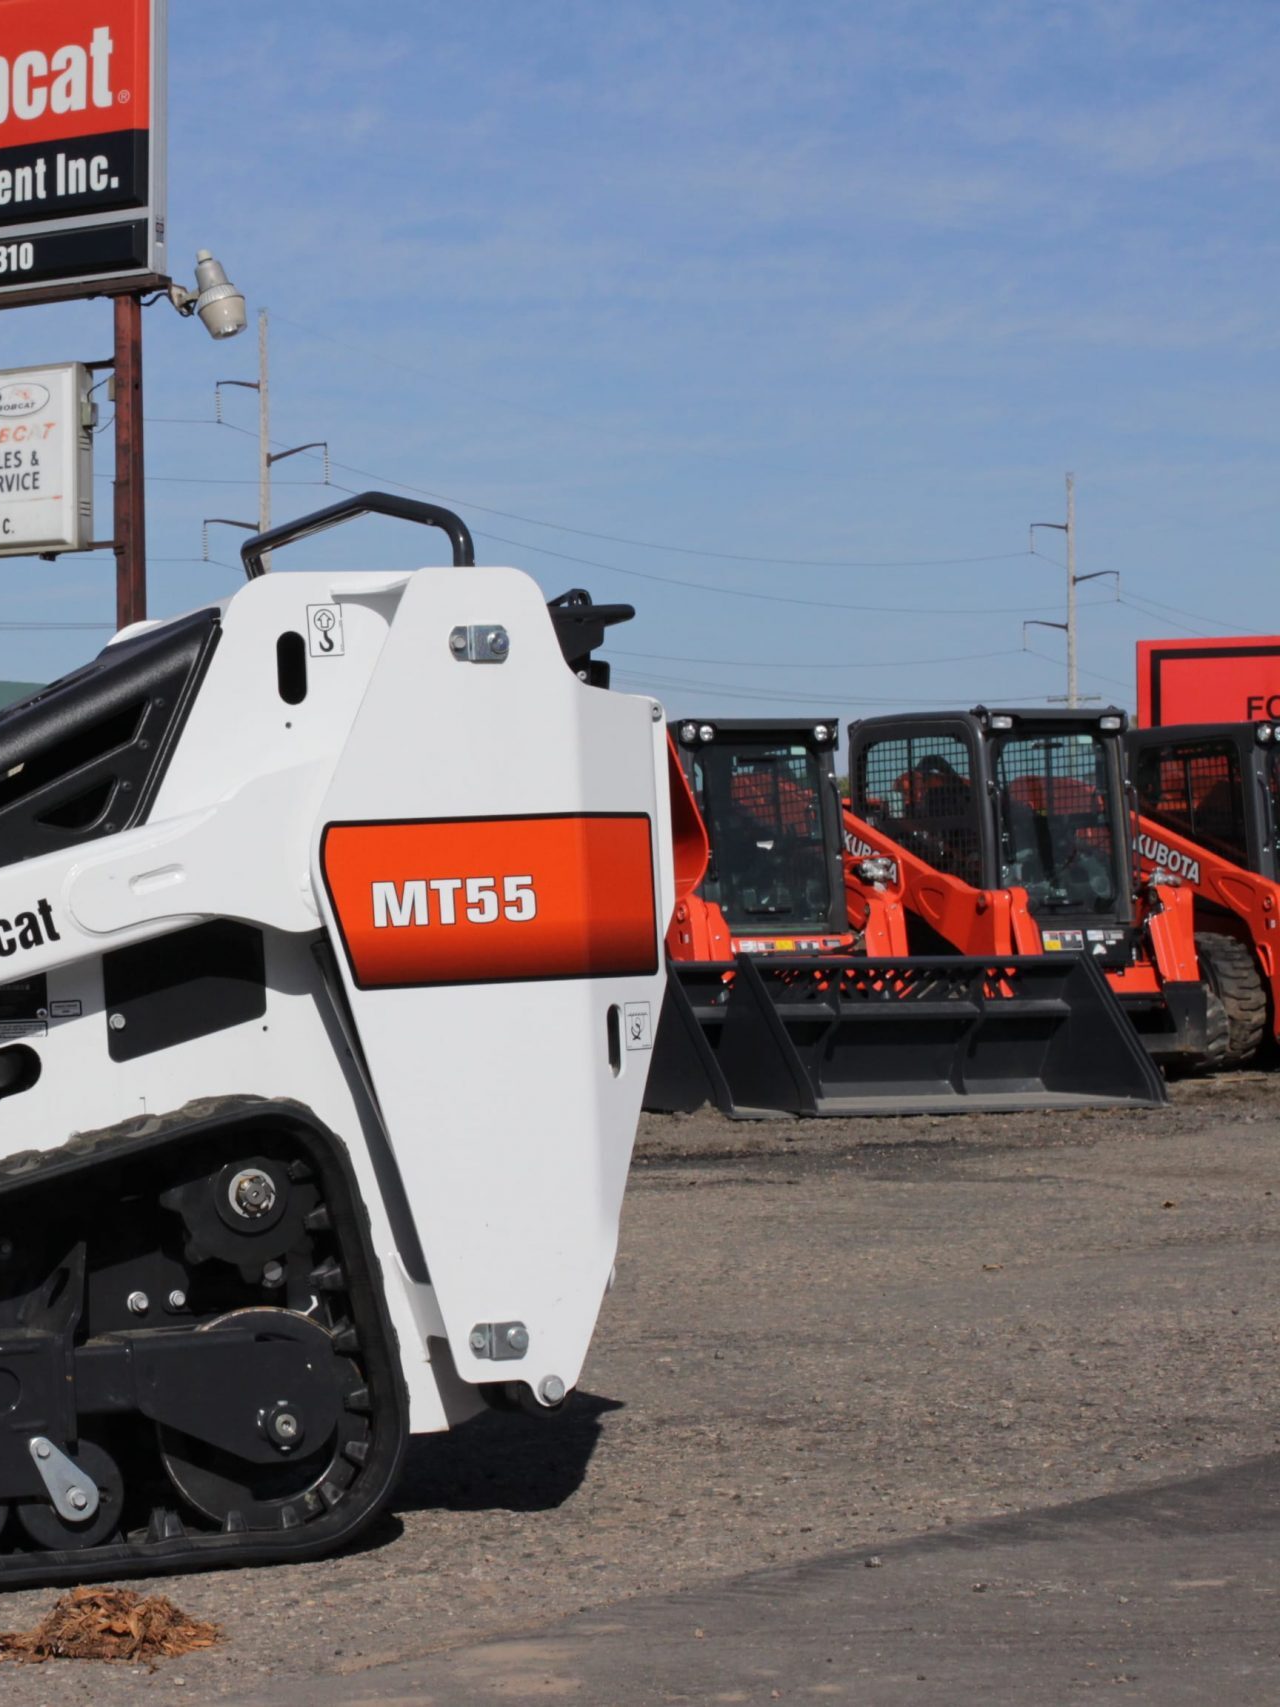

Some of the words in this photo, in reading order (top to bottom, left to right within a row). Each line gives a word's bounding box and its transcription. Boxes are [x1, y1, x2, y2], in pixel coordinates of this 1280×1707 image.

[56, 153, 119, 196] Inc.
[30, 450, 40, 467] &
[843, 830, 897, 884] KUBA
[1132, 833, 1200, 884] KUBOTA
[371, 875, 538, 928] MT55
